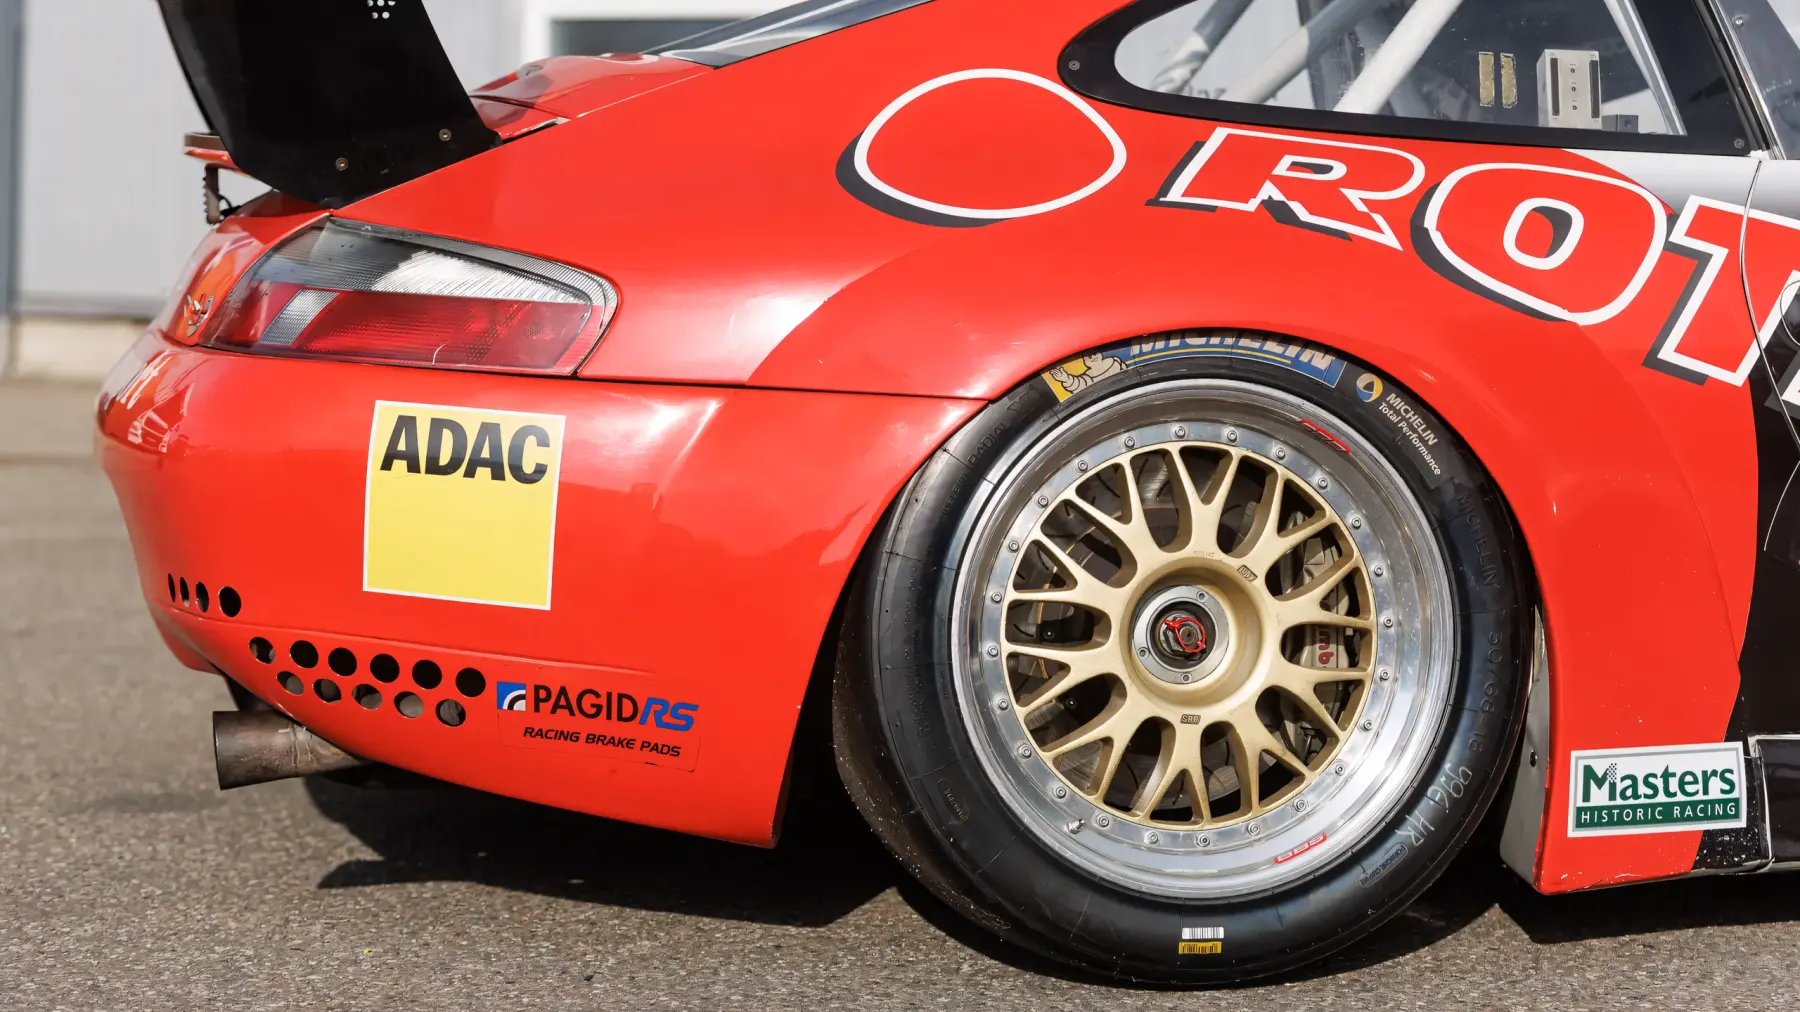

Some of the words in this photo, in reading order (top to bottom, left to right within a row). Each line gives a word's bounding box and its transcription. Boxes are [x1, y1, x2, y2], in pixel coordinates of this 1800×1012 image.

[1148, 126, 1800, 400] ROT
[380, 405, 550, 485] ADAC
[1379, 402, 1401, 423] Total
[1398, 420, 1441, 475] Performance
[1386, 393, 1438, 445] MICHELIN
[1456, 491, 1500, 588] MICHELIN
[523, 726, 581, 743] RACING
[584, 733, 636, 750] BRAKE
[639, 740, 682, 758] PADS
[1582, 763, 1736, 803] Masters
[1394, 810, 1435, 847] HR
[1581, 807, 1663, 824] HISTORIC
[1673, 802, 1736, 819] RACING
